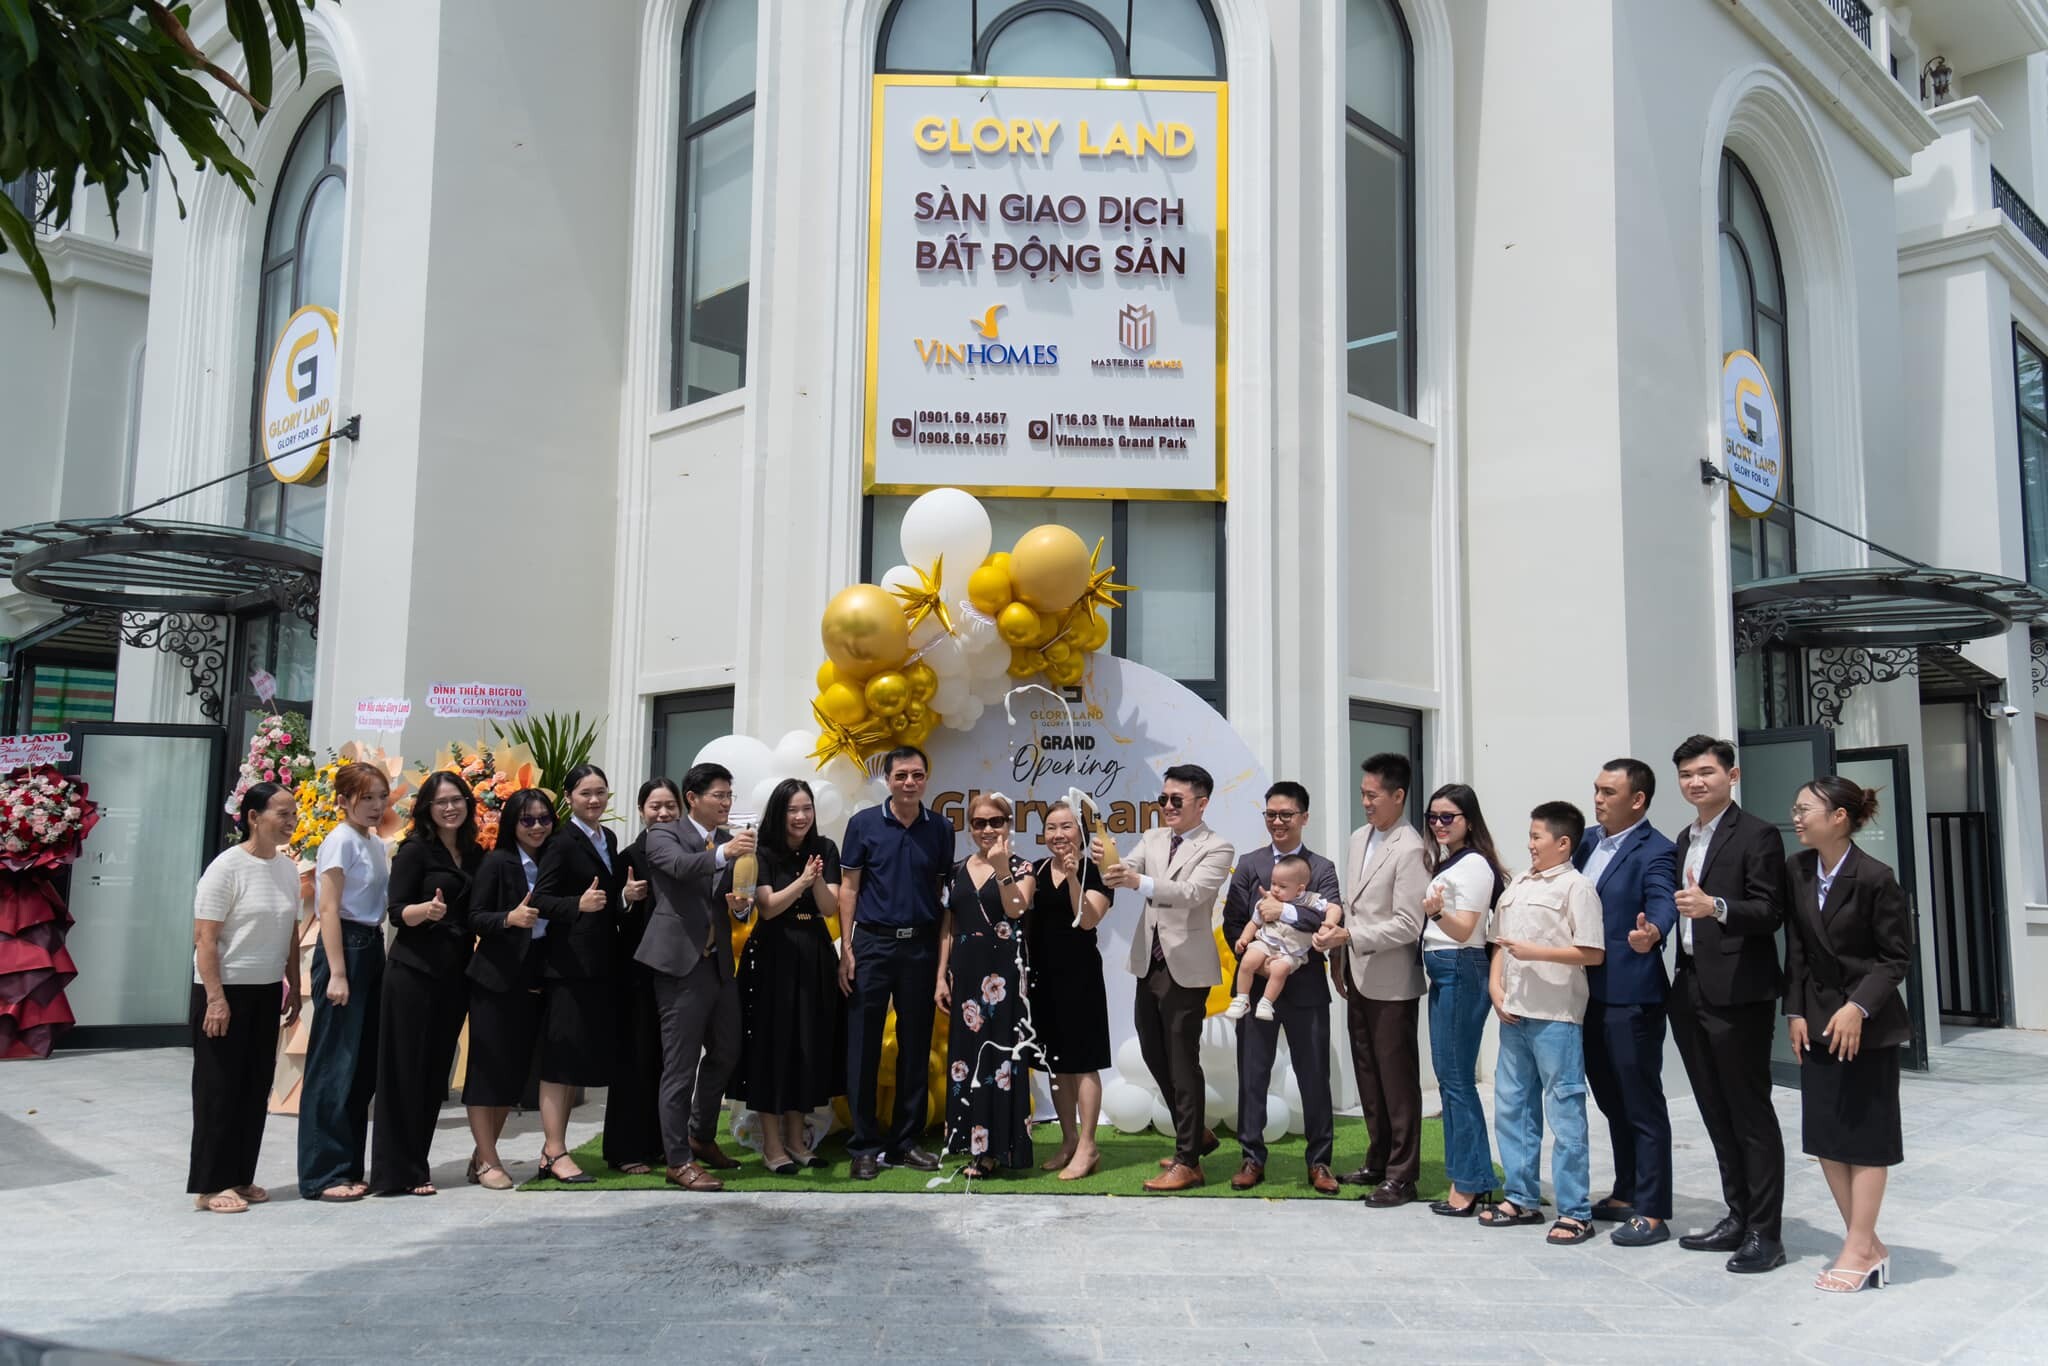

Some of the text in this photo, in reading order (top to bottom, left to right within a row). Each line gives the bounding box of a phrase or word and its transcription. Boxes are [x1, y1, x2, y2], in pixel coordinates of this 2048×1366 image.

[913, 115, 1196, 158] GLORY LAND
[914, 184, 1184, 232] SÀN GIAO DỊCH
[915, 232, 1185, 279] BẤT ĐỘNG SẢN
[914, 338, 1058, 366] VINHOMES
[1091, 358, 1183, 370] MASTERISE HOMES
[269, 398, 330, 438] GLORY LAND
[918, 410, 1007, 425] 0901.69.4567
[1056, 413, 1195, 428] T16.03 The Manhattan
[278, 424, 319, 450] GLORY FOR US
[918, 431, 1007, 446] 0908.69.4567
[1118, 435, 1154, 448] Grand
[1158, 436, 1187, 449] Park
[1726, 438, 1777, 476] GLORY LAND
[1734, 463, 1770, 488] GLORY FOR US
[433, 684, 456, 695] ĐÌNH
[459, 684, 486, 698] THIỆN
[1030, 710, 1104, 720] GLORY LAND
[21, 733, 69, 744] LAND
[1041, 735, 1095, 750] GRAND
[1012, 743, 1126, 798] Opening
